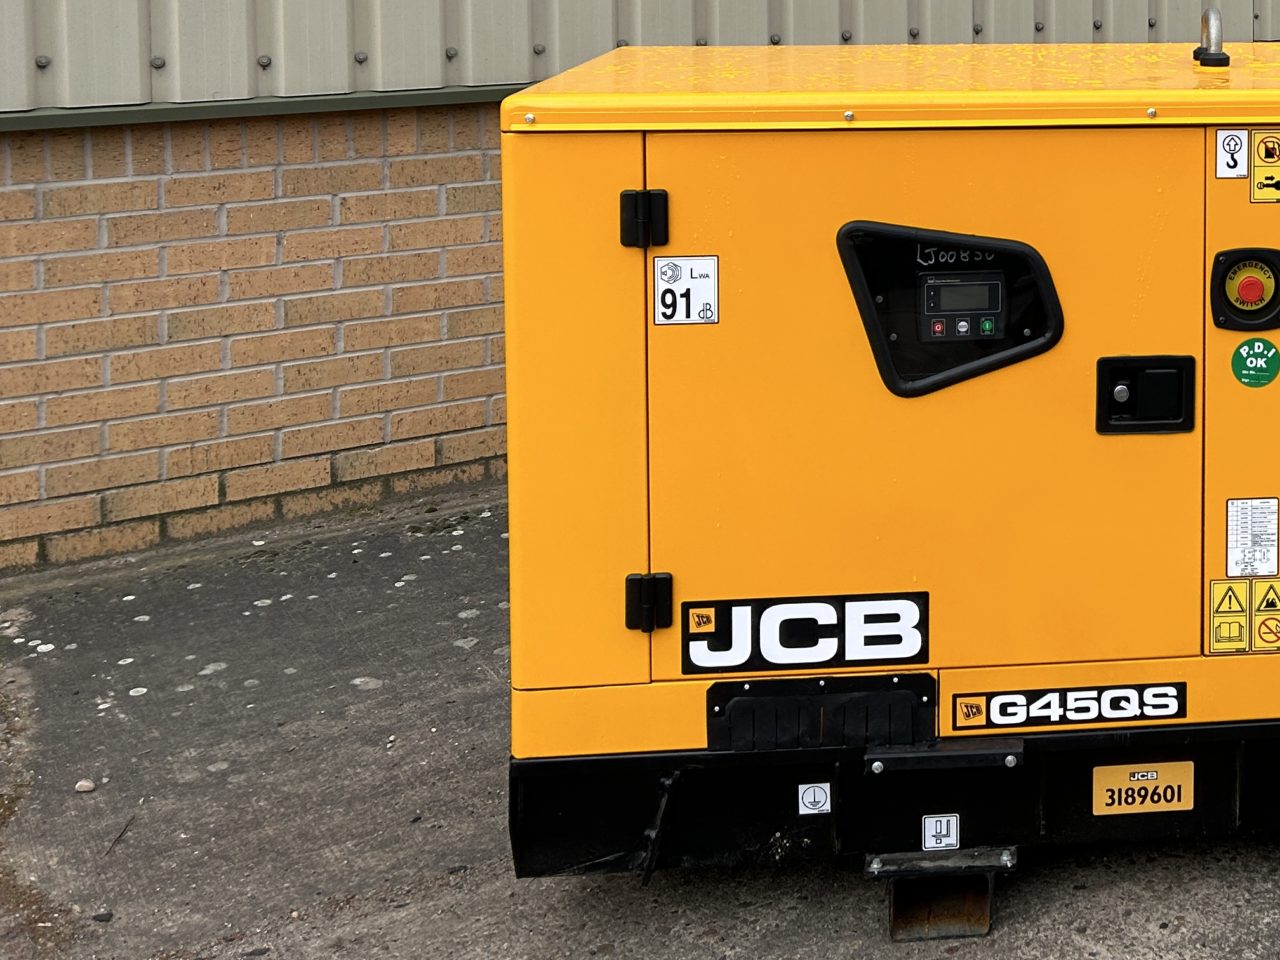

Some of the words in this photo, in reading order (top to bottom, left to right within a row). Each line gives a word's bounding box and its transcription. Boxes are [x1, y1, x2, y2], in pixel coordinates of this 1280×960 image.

[1229, 261, 1273, 281] EMERGENCY
[660, 287, 691, 320] 91
[1233, 295, 1267, 308] SWITCH
[1246, 357, 1267, 368] OK
[689, 599, 922, 667] JCB
[989, 686, 1179, 725] G45QS
[1130, 771, 1157, 781] JCB
[1105, 784, 1182, 807] 3189601
